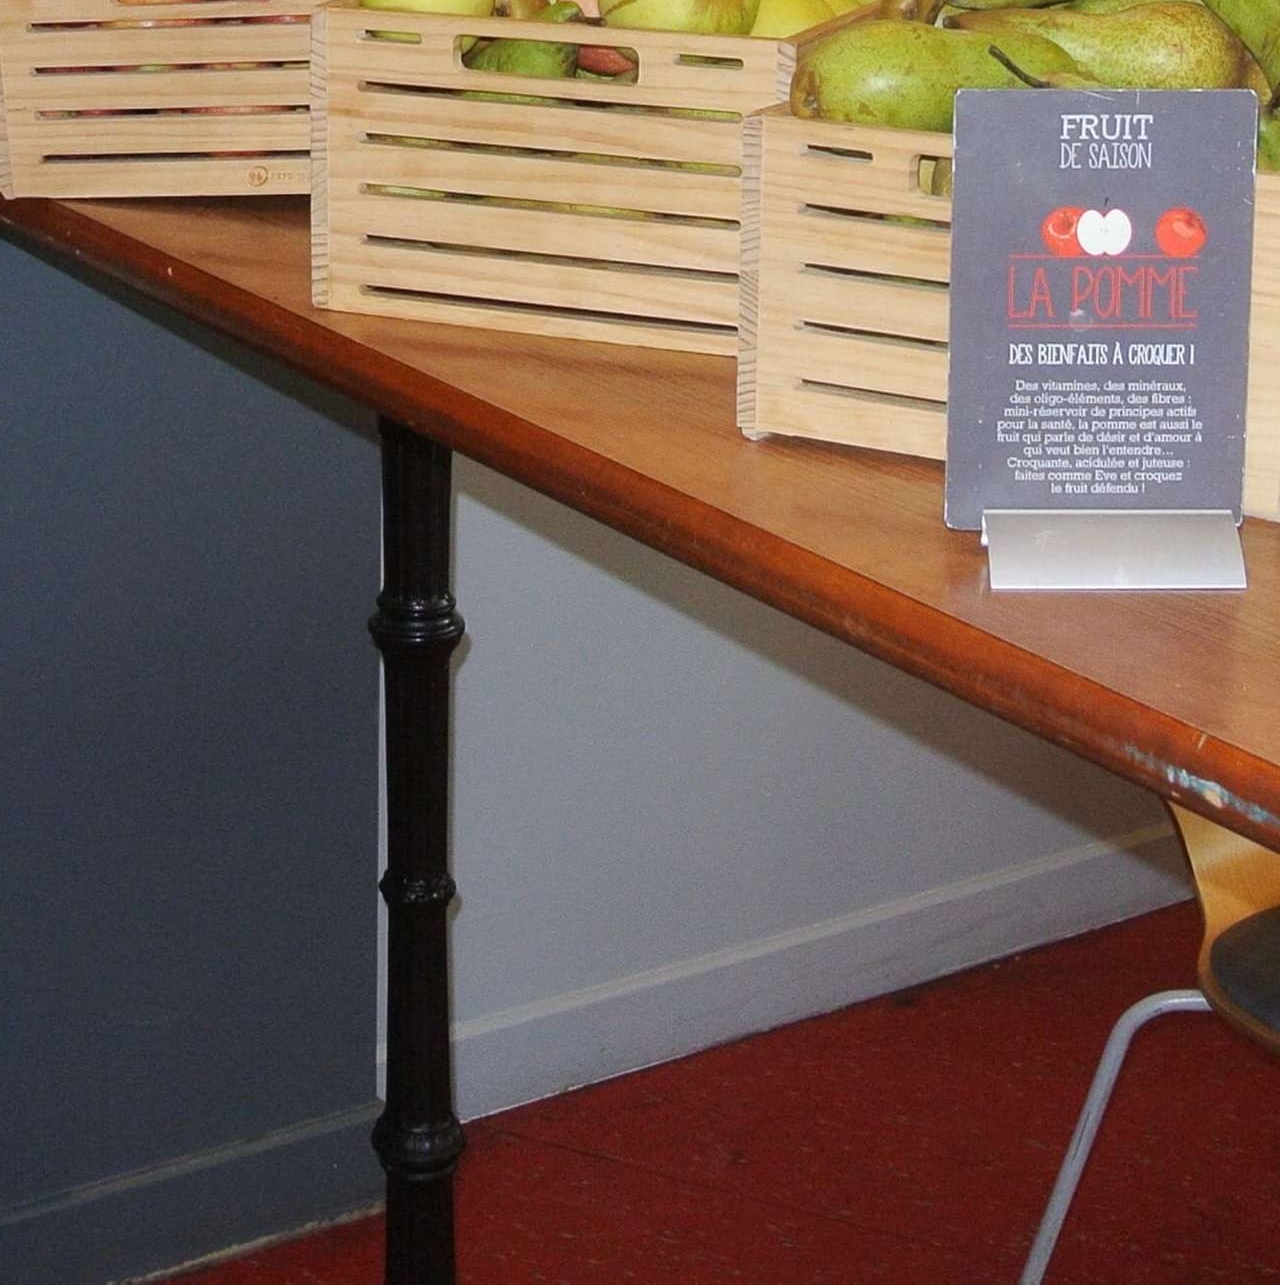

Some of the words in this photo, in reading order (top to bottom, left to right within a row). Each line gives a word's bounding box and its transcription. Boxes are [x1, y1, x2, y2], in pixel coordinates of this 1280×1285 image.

[1060, 114, 1154, 140] FRUIT
[1059, 143, 1082, 169] DE
[1089, 142, 1152, 169] SAISON
[1008, 265, 1054, 318] LA
[1072, 265, 1198, 318] POMME
[1009, 343, 1033, 365] DES
[1038, 343, 1108, 365] BIENFAITS
[1112, 341, 1124, 365] À
[1128, 343, 1185, 365] CROQUER
[1015, 380, 1039, 391] Des
[1042, 379, 1100, 392] vitamines,
[1103, 380, 1125, 391] des
[1128, 379, 1186, 392] minéraux,
[1009, 393, 1031, 404] des
[1034, 393, 1124, 406] oligo-éléments,
[1127, 393, 1148, 404] des
[1151, 393, 1185, 404] fibres
[1004, 406, 1087, 417] mini-réservoir
[1090, 406, 1106, 417] de
[1108, 406, 1163, 419] principes
[1166, 406, 1197, 417] actifs
[997, 420, 1024, 432] pour
[1028, 419, 1038, 430] la
[1078, 418, 1088, 430] la
[1091, 421, 1137, 432] pomme
[1139, 420, 1157, 430] est
[1159, 419, 1189, 430] aussi
[1192, 419, 1203, 430] le
[997, 431, 1019, 442] fruit
[1022, 431, 1041, 444] qui
[1044, 431, 1075, 444] parle
[1078, 432, 1093, 442] de
[1096, 431, 1125, 442] désir
[1129, 432, 1140, 442] et
[1195, 431, 1203, 442] à
[1023, 444, 1042, 457] qui
[1045, 445, 1070, 455] veut
[1073, 444, 1099, 455] bien
[1007, 457, 1072, 470] Croquante,
[1075, 457, 1125, 468] acidulée
[1128, 458, 1139, 468] et
[1141, 457, 1184, 470] juteuse
[1014, 470, 1045, 481] faites
[1047, 471, 1092, 481] comme
[1095, 470, 1118, 481] Eve
[1120, 471, 1132, 481] et
[1134, 471, 1183, 483] croquez
[1051, 483, 1062, 493] le
[1065, 482, 1088, 493] fruit
[1091, 482, 1138, 493] défendu
